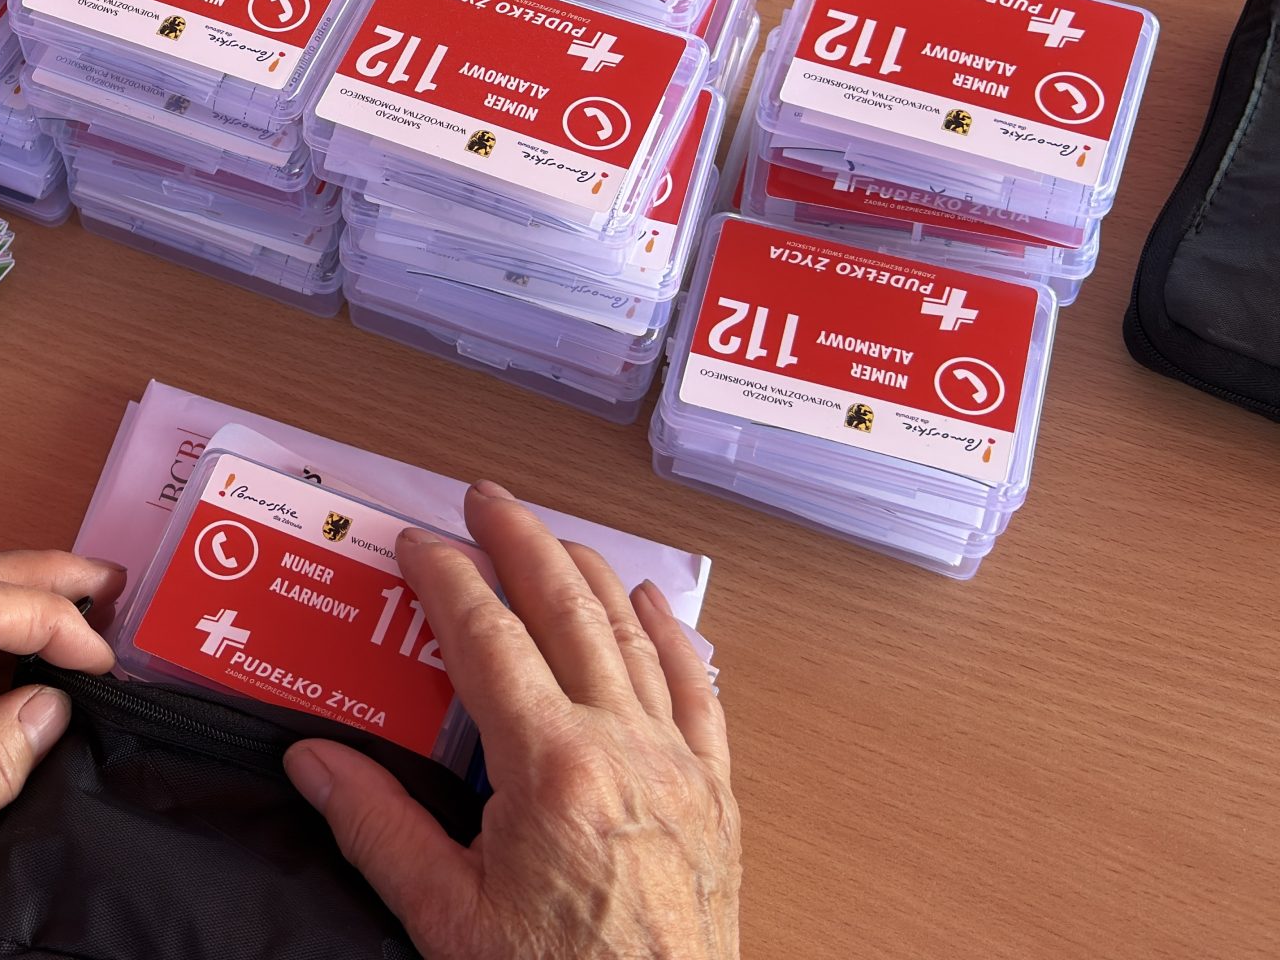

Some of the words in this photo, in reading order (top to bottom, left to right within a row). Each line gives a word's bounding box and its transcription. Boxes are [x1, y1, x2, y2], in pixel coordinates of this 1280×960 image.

[494, 1, 586, 36] PUDEŁKO
[207, 33, 273, 61] Pomorskie
[813, 8, 905, 74] 112
[355, 24, 447, 92] 112
[920, 42, 1016, 75] ALARMOWY
[457, 61, 549, 98] ALARMOWY
[802, 72, 868, 94] POMORSKIEGO
[952, 71, 1008, 97] NUMER
[340, 87, 401, 112] POMORSKIEGO
[483, 92, 538, 120] NUMER
[843, 92, 892, 110] SAMORZĄD
[871, 89, 939, 114] WOJEWÓDZTWA
[375, 108, 421, 128] SAMORZĄD
[403, 107, 465, 134] WOJEWÓDZTWA
[999, 127, 1077, 155] Pomorskie
[521, 150, 595, 182] Pomorskie
[769, 245, 829, 271] ŻYCIA
[785, 240, 815, 250] BLISKICH
[820, 247, 842, 256] SWOJE
[843, 253, 902, 270] BEZPIECZEŃSTWO
[909, 267, 935, 278] ZADBAJ
[835, 261, 933, 293] PUDEŁKO
[707, 296, 798, 367] 112
[815, 329, 913, 364] ALARMOWY
[699, 368, 767, 390] POMORSKIEGO
[850, 361, 907, 388] NUMER
[741, 388, 792, 406] SAMORZĄD
[770, 385, 840, 409] WOJEWÓDZTWA
[901, 421, 981, 450] Pomorskie
[230, 486, 298, 519] Pomorskie
[280, 552, 334, 585] NUMER
[269, 578, 360, 622] ALARMOWY
[229, 652, 322, 698] PUDEŁKO
[325, 690, 386, 727] ŻYCIA
